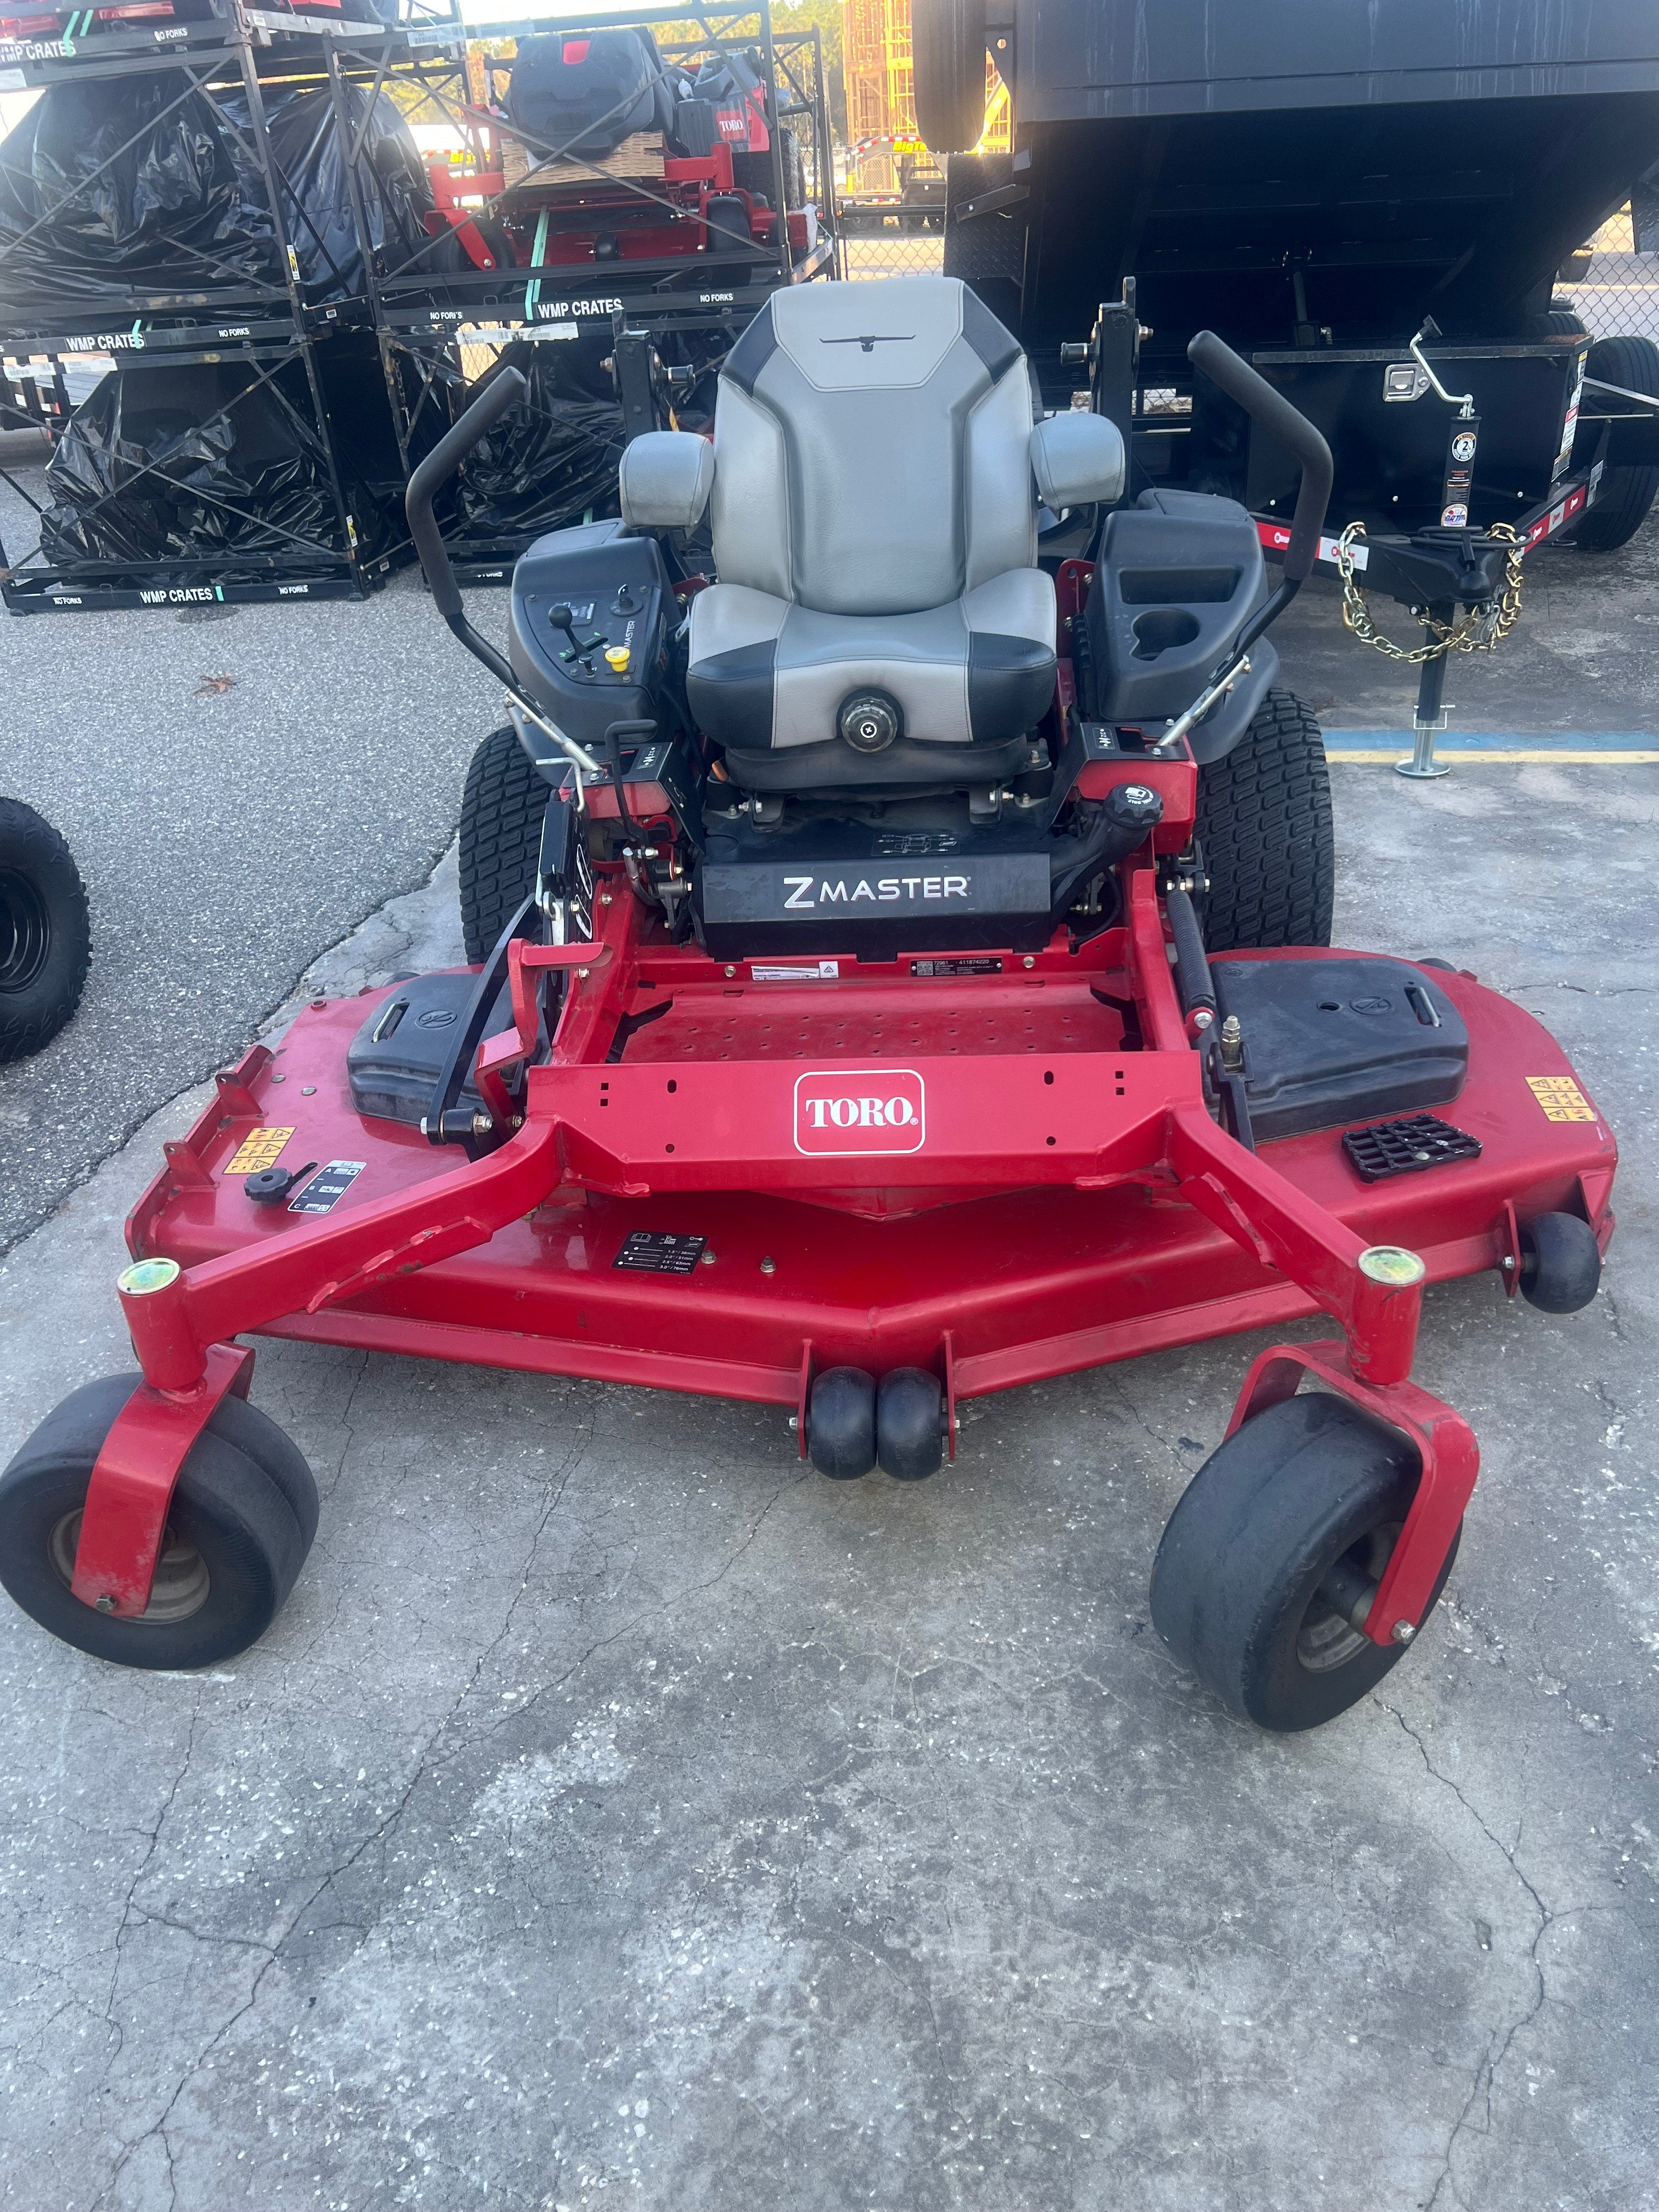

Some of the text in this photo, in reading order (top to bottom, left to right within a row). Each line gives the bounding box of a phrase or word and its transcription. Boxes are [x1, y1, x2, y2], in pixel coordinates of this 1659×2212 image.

[165, 27, 188, 38] FORKS
[25, 40, 76, 60] CRATES
[719, 119, 743, 132] TORO
[893, 141, 927, 154] BigTe
[700, 293, 733, 302] NO FORKS
[538, 298, 624, 318] WMP CRATES
[218, 327, 250, 337] NO FORKS
[66, 333, 145, 351] WMP CRATES
[139, 588, 213, 603] WMP CRATES
[783, 876, 967, 909] Z MASTER
[805, 1097, 913, 1127] TORO
